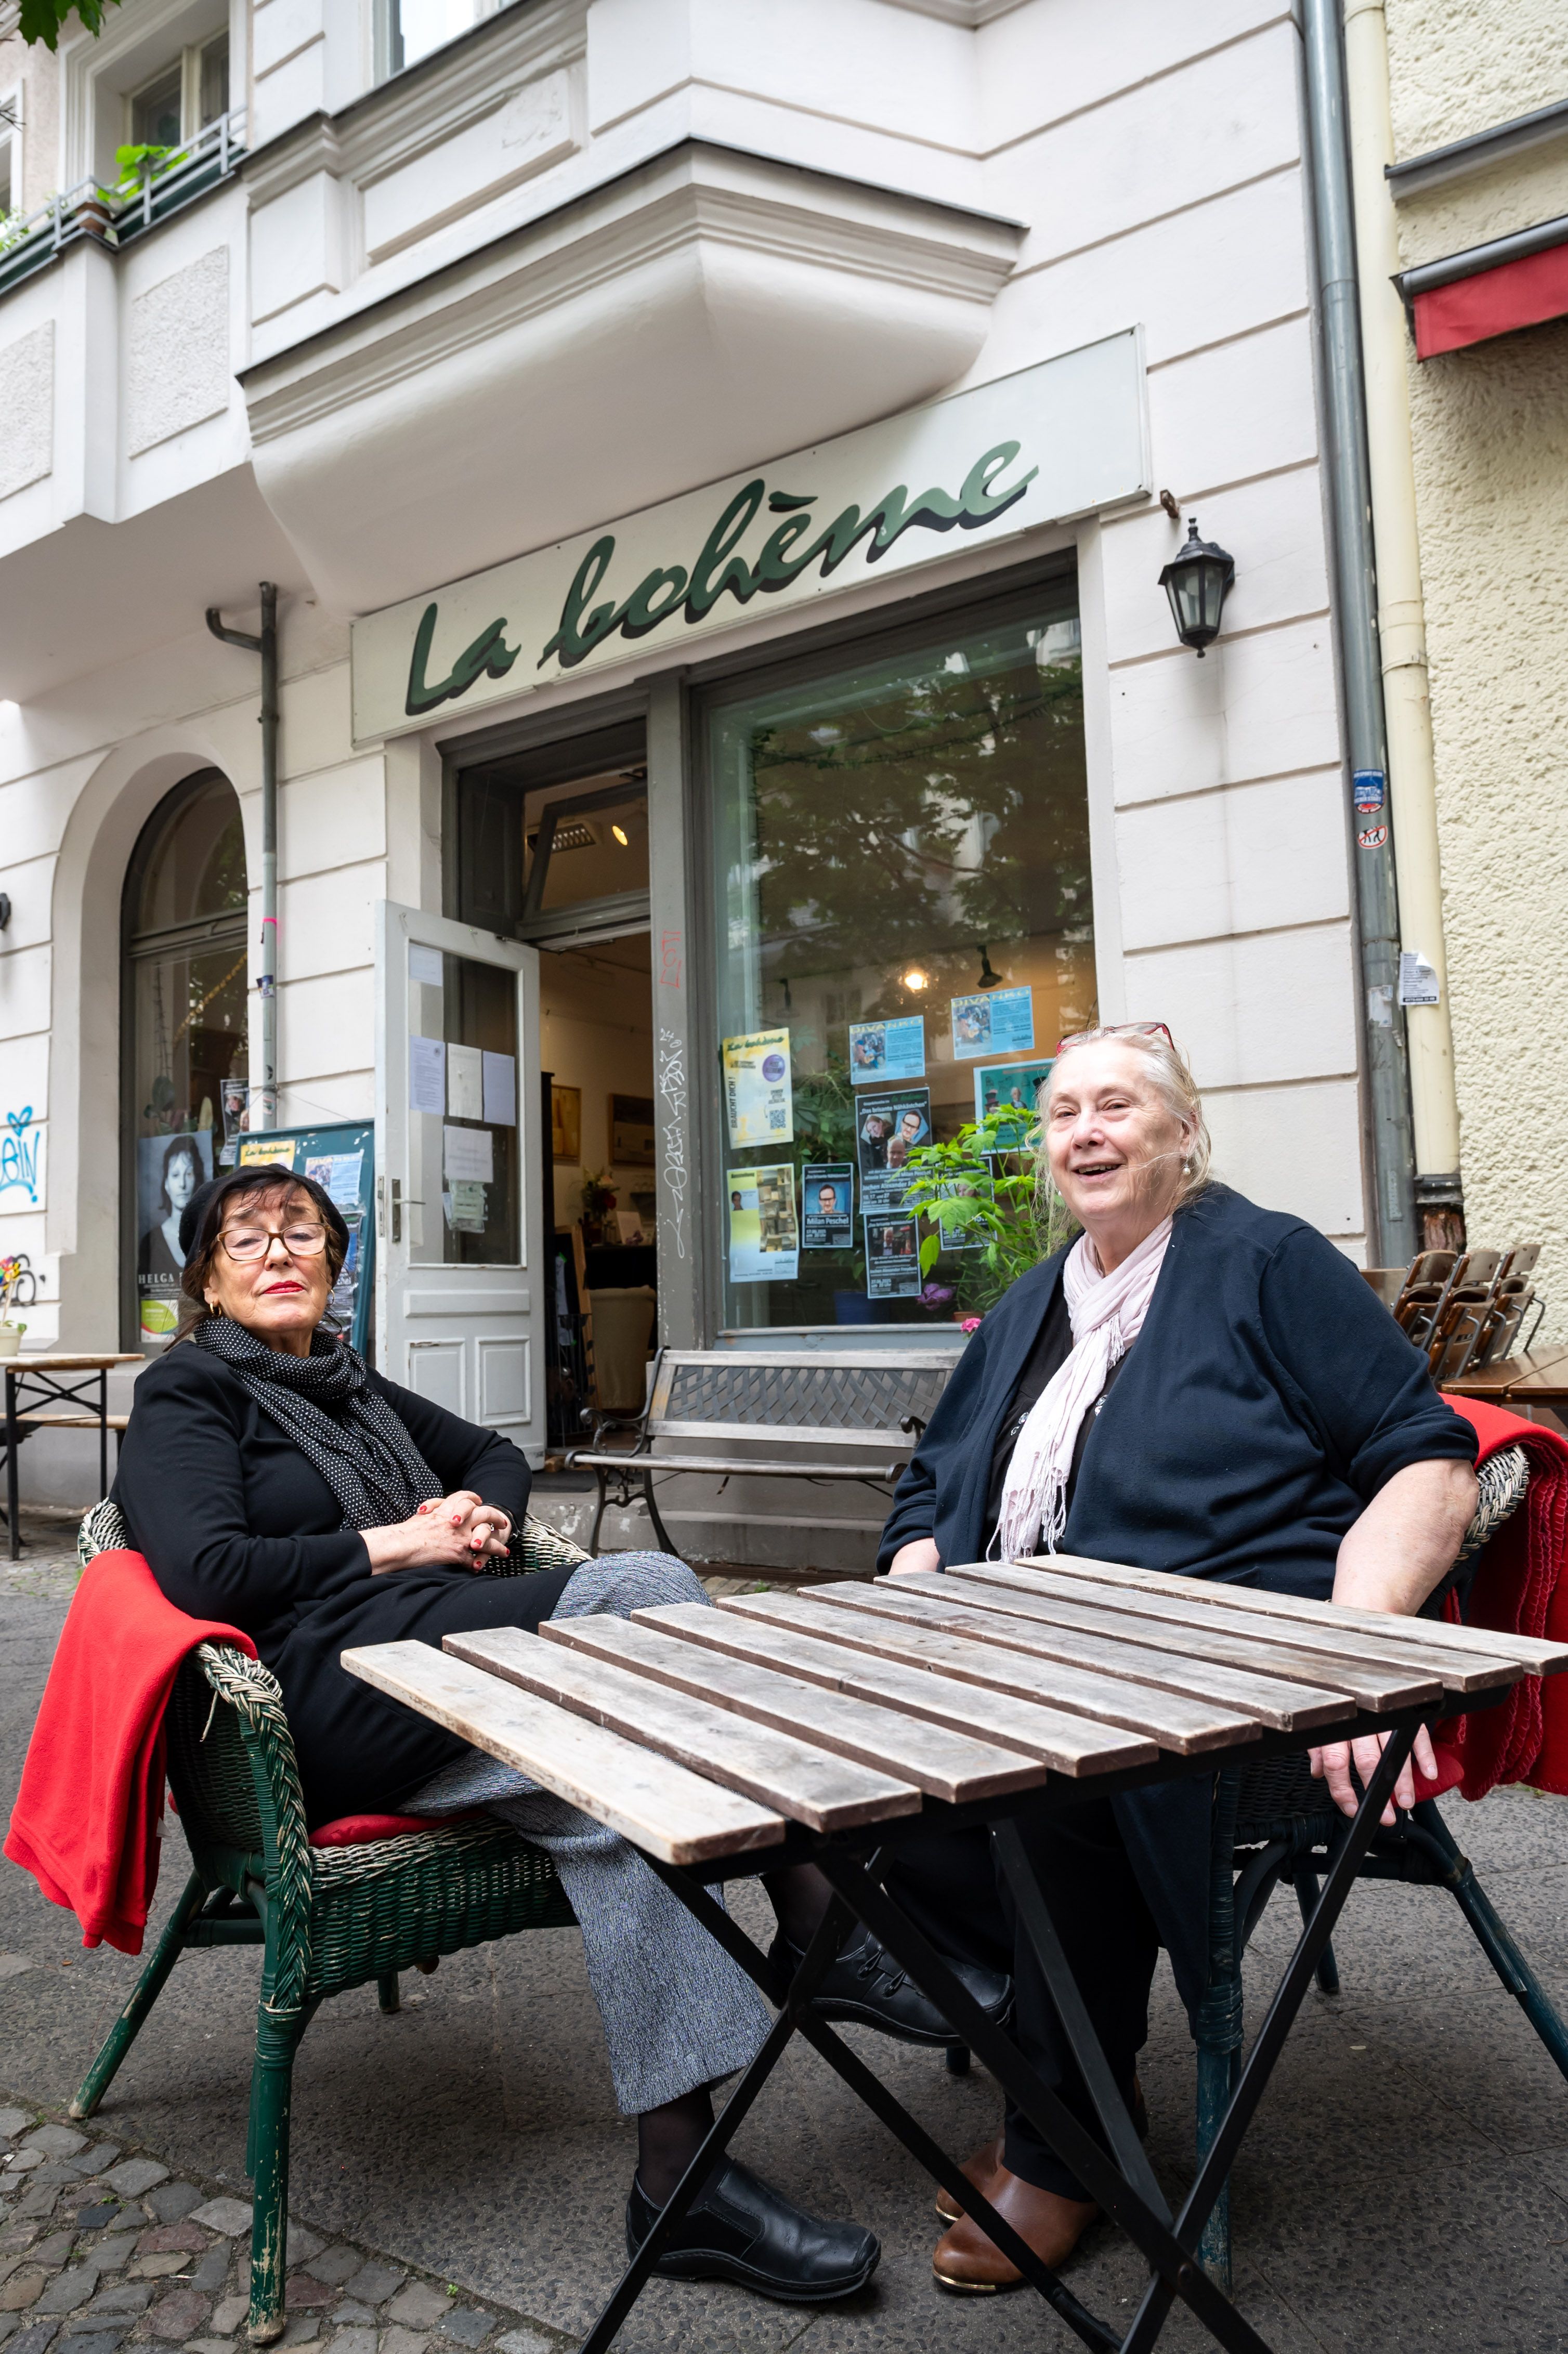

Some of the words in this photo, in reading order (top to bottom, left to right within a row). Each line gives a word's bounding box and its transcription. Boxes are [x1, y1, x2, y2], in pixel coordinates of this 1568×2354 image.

[405, 602, 521, 716] La
[537, 440, 1039, 669] bohème
[138, 1273, 174, 1284] HELGA
